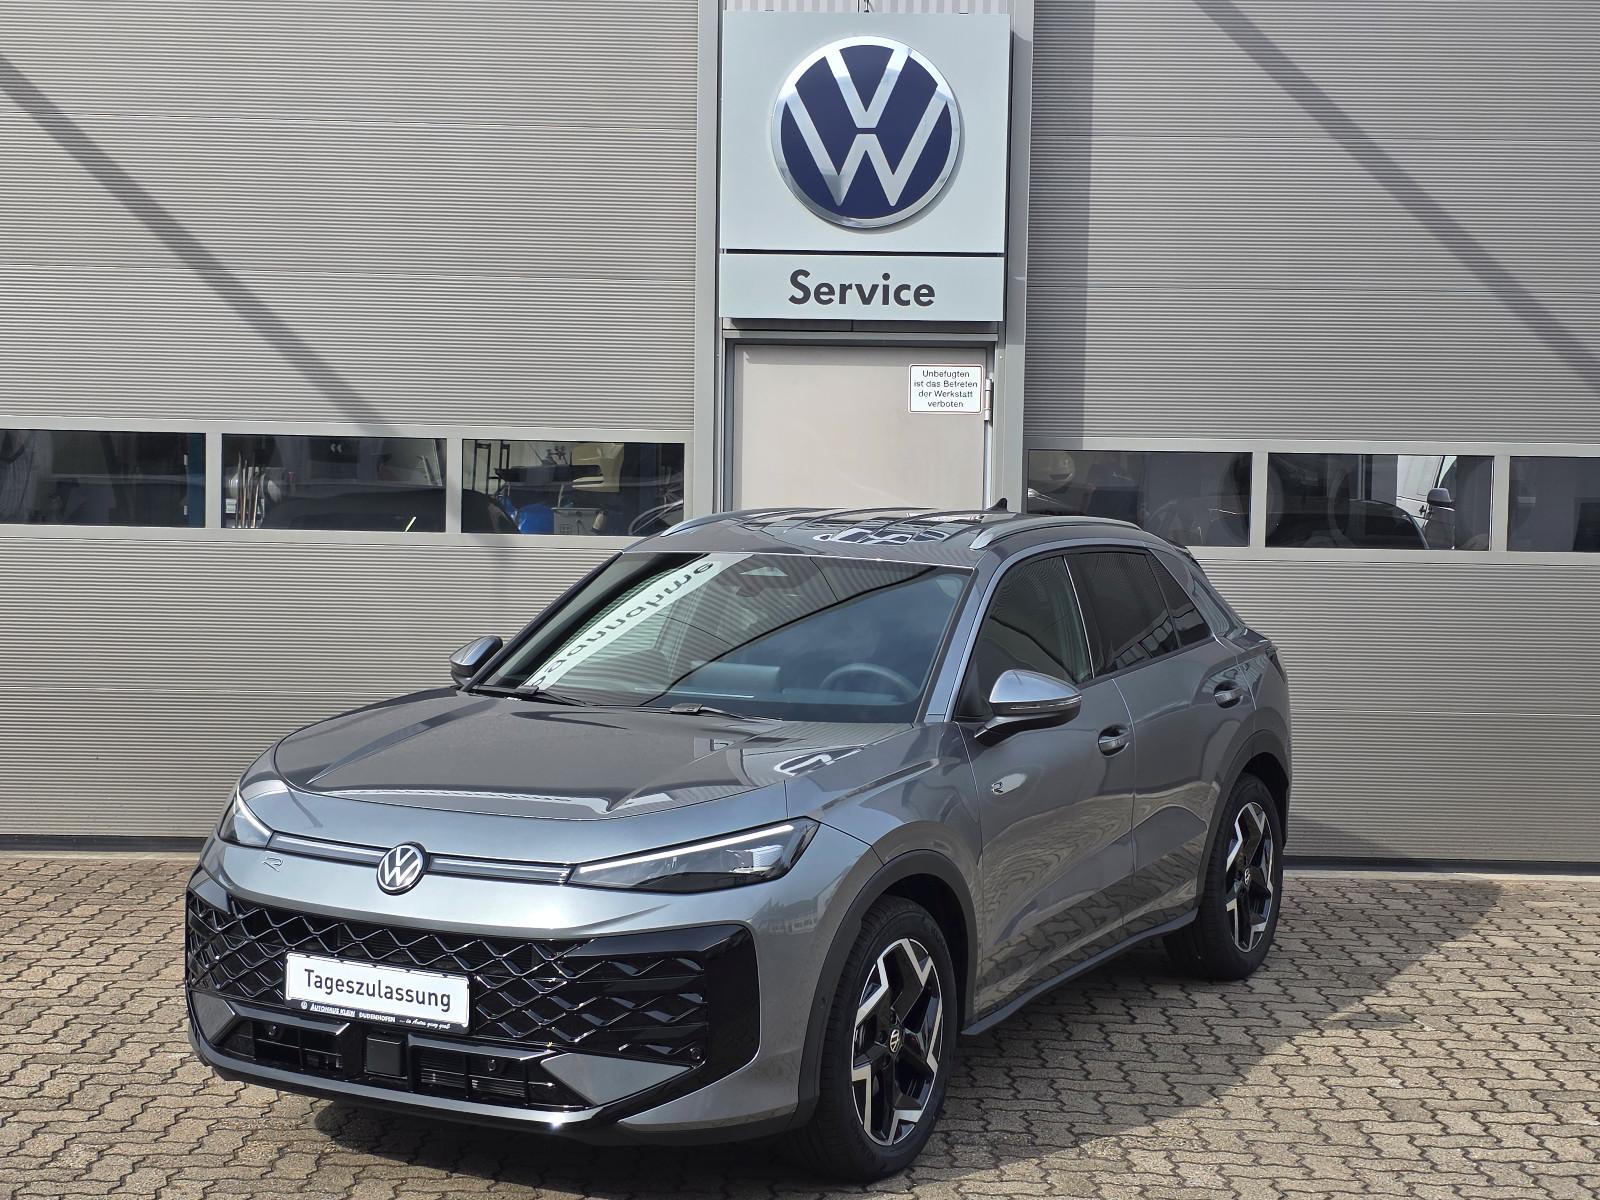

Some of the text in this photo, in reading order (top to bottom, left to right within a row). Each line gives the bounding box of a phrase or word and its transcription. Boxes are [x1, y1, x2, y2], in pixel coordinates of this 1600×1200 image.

[788, 268, 936, 307] Service
[922, 369, 970, 379] Unbefugten
[914, 380, 978, 388] ist das Betreten
[918, 390, 973, 398] der Werkstatt
[928, 400, 963, 408] verboten
[304, 968, 451, 1012] Tageszulassung
